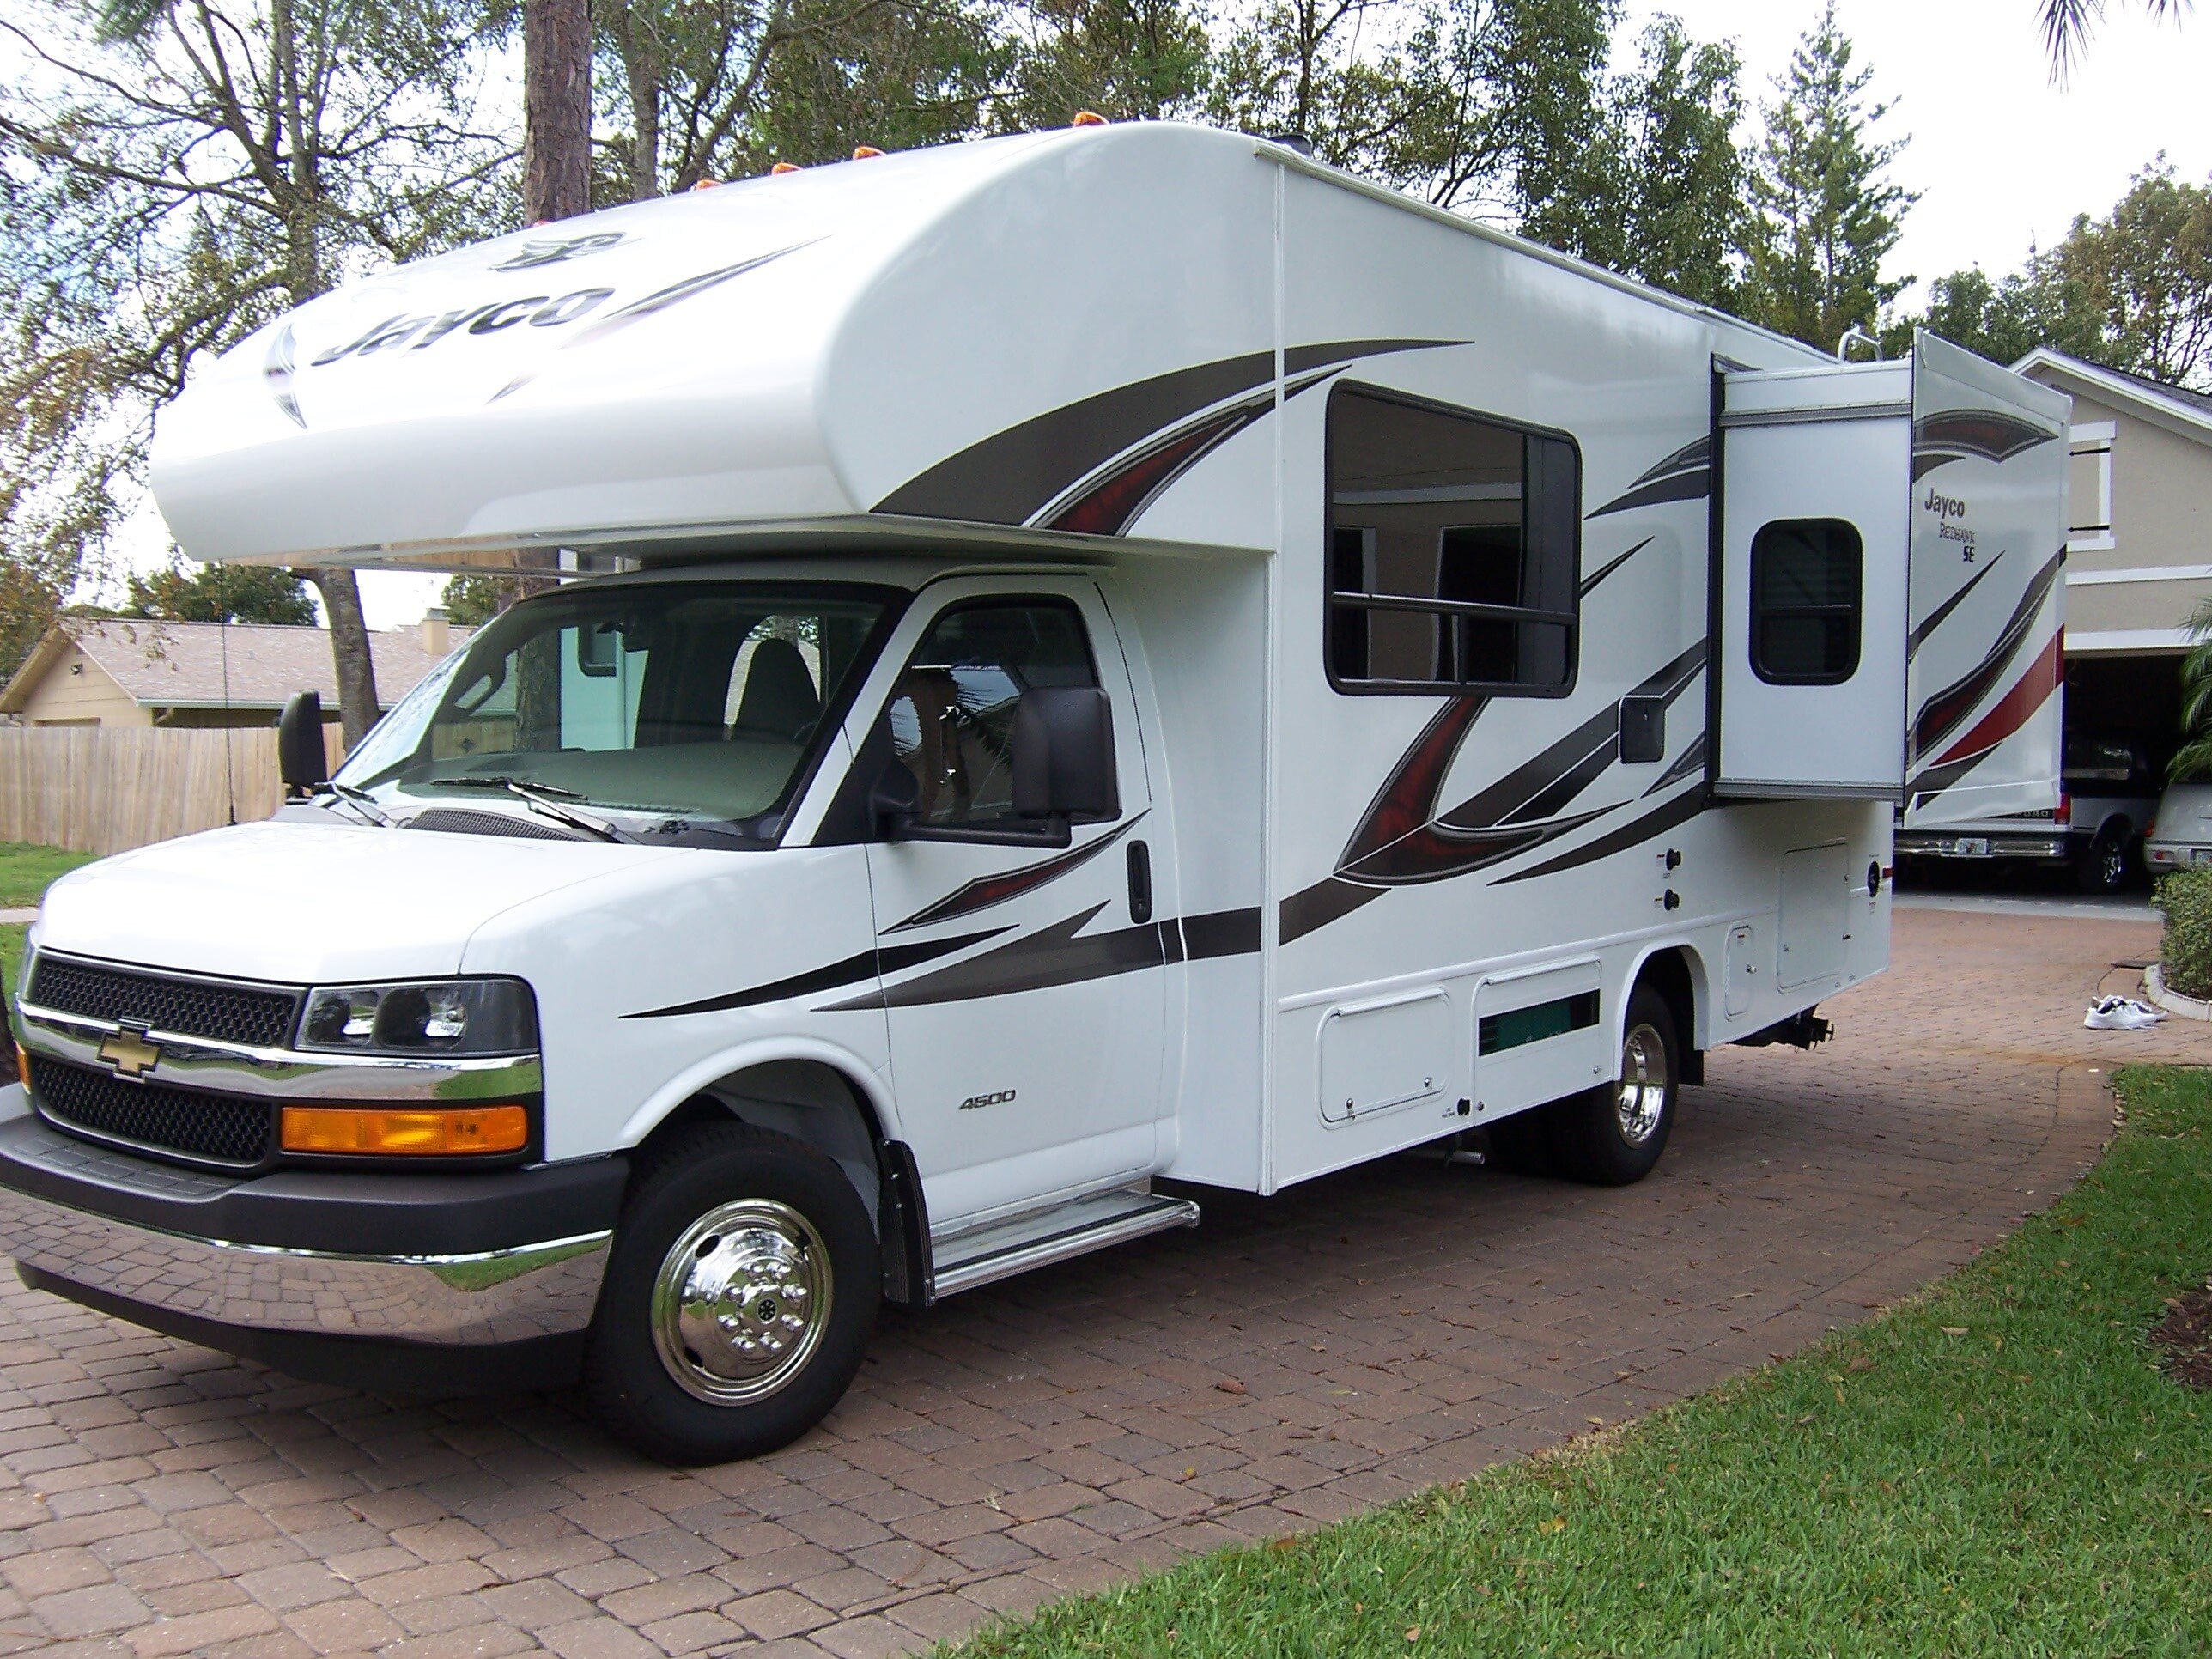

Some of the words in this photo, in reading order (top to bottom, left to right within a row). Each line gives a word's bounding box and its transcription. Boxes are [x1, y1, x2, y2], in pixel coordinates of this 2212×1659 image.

[310, 287, 616, 367] Jayco
[1924, 488, 1965, 519] Jayco
[1963, 545, 1975, 563] SE
[958, 1089, 1017, 1110] 4500
